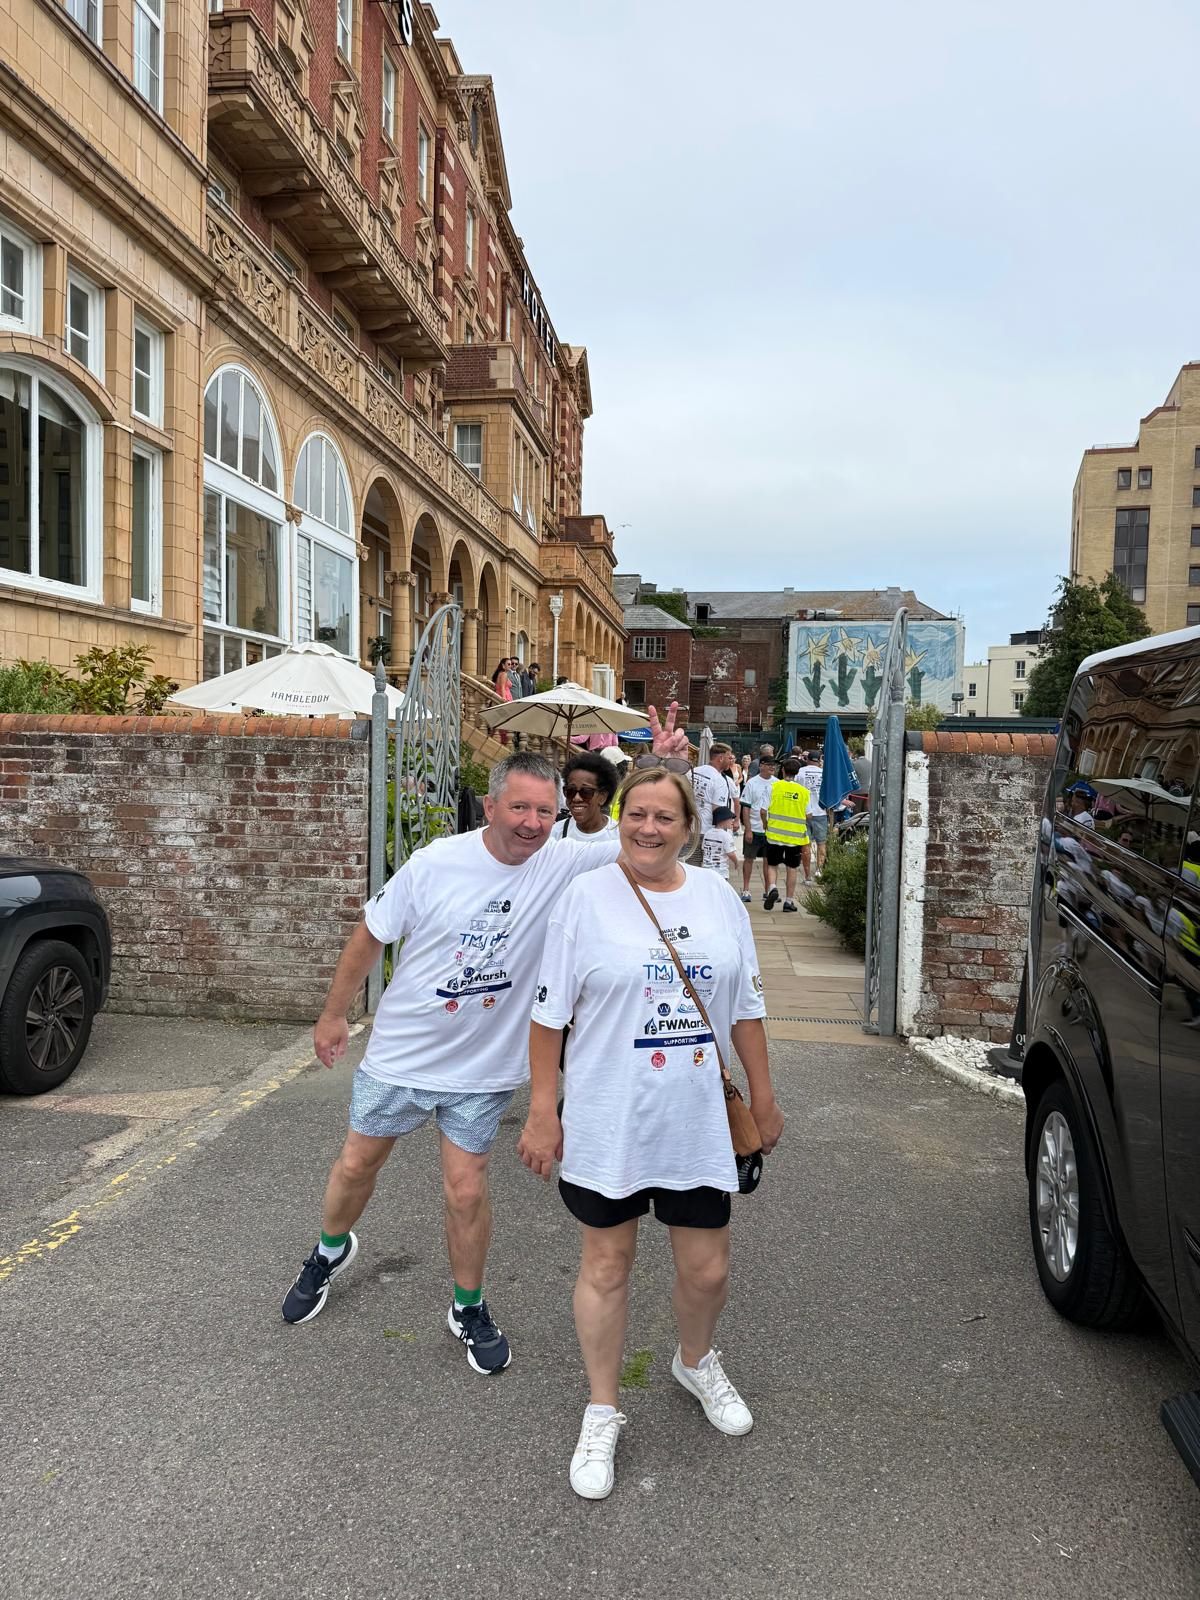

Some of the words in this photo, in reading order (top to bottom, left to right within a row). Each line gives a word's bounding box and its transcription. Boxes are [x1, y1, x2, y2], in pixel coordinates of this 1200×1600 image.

[523, 269, 556, 367] HOTEL
[271, 691, 330, 703] HAMBLEDON
[643, 965, 673, 983] TMJ
[664, 1037, 698, 1046] SUPPORTING
